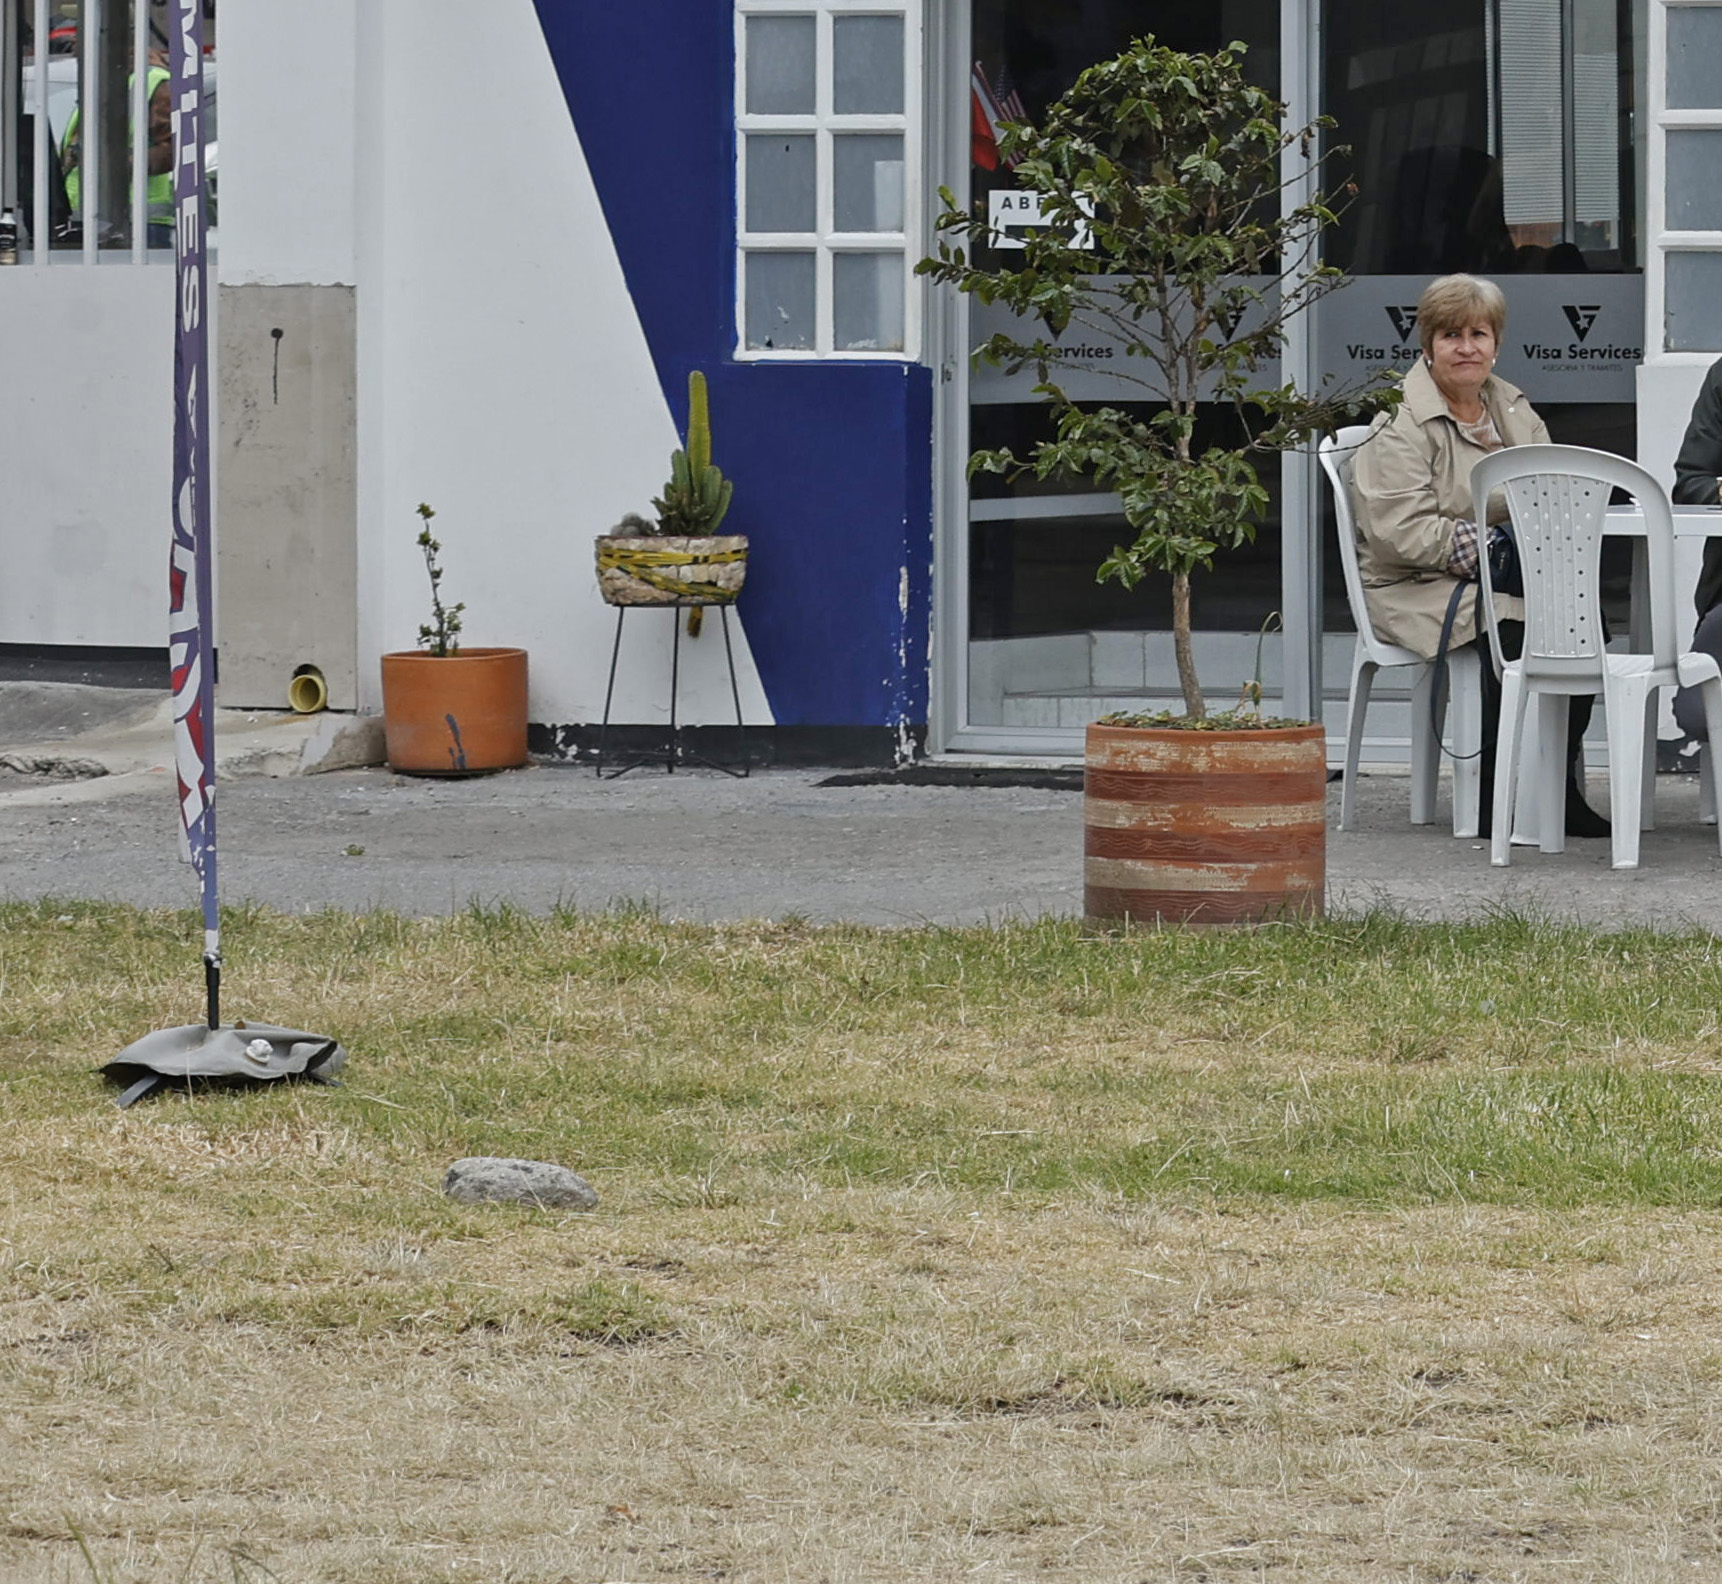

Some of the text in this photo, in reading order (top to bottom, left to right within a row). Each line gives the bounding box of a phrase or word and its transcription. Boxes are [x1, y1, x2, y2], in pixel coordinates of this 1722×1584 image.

[1346, 344, 1385, 360] Visa
[1522, 342, 1642, 360] Visa Services
